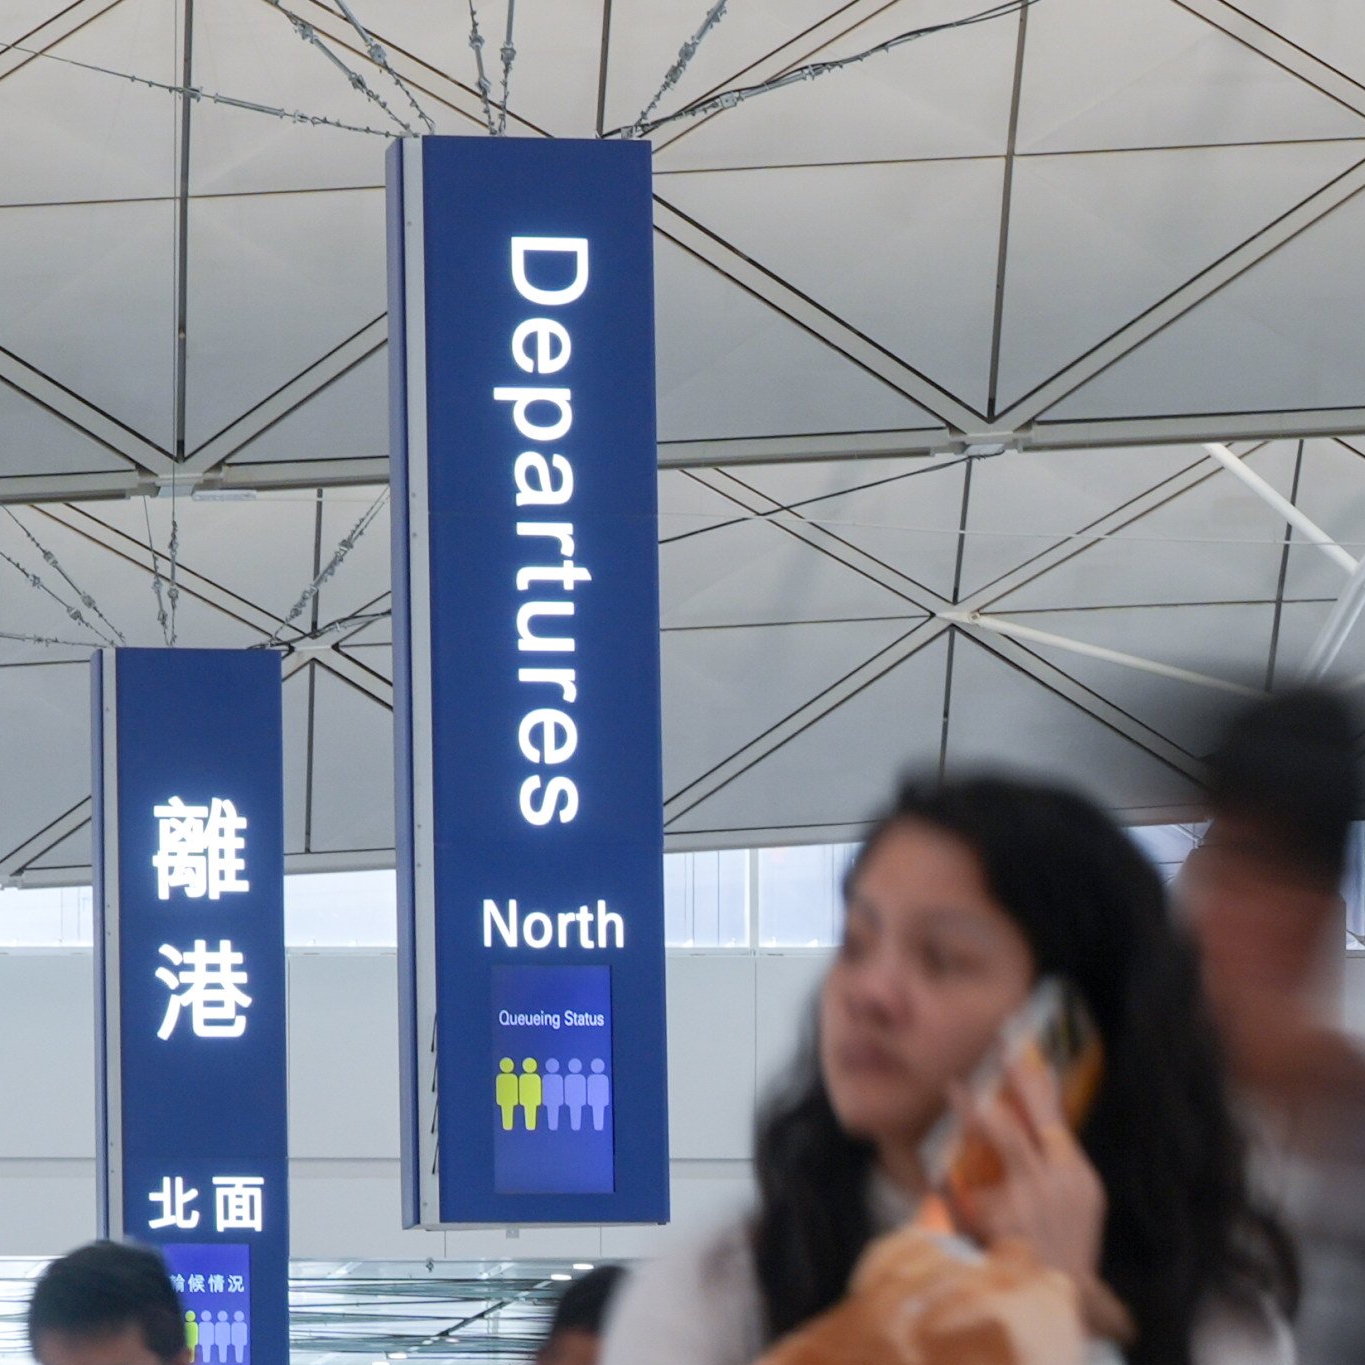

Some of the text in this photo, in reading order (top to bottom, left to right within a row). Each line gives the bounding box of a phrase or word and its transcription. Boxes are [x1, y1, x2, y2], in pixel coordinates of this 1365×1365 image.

[493, 236, 592, 826] Departures
[151, 796, 253, 1041] 離港
[483, 899, 625, 949] North
[498, 1009, 605, 1030] Queueing Status
[148, 1176, 265, 1233] 北面
